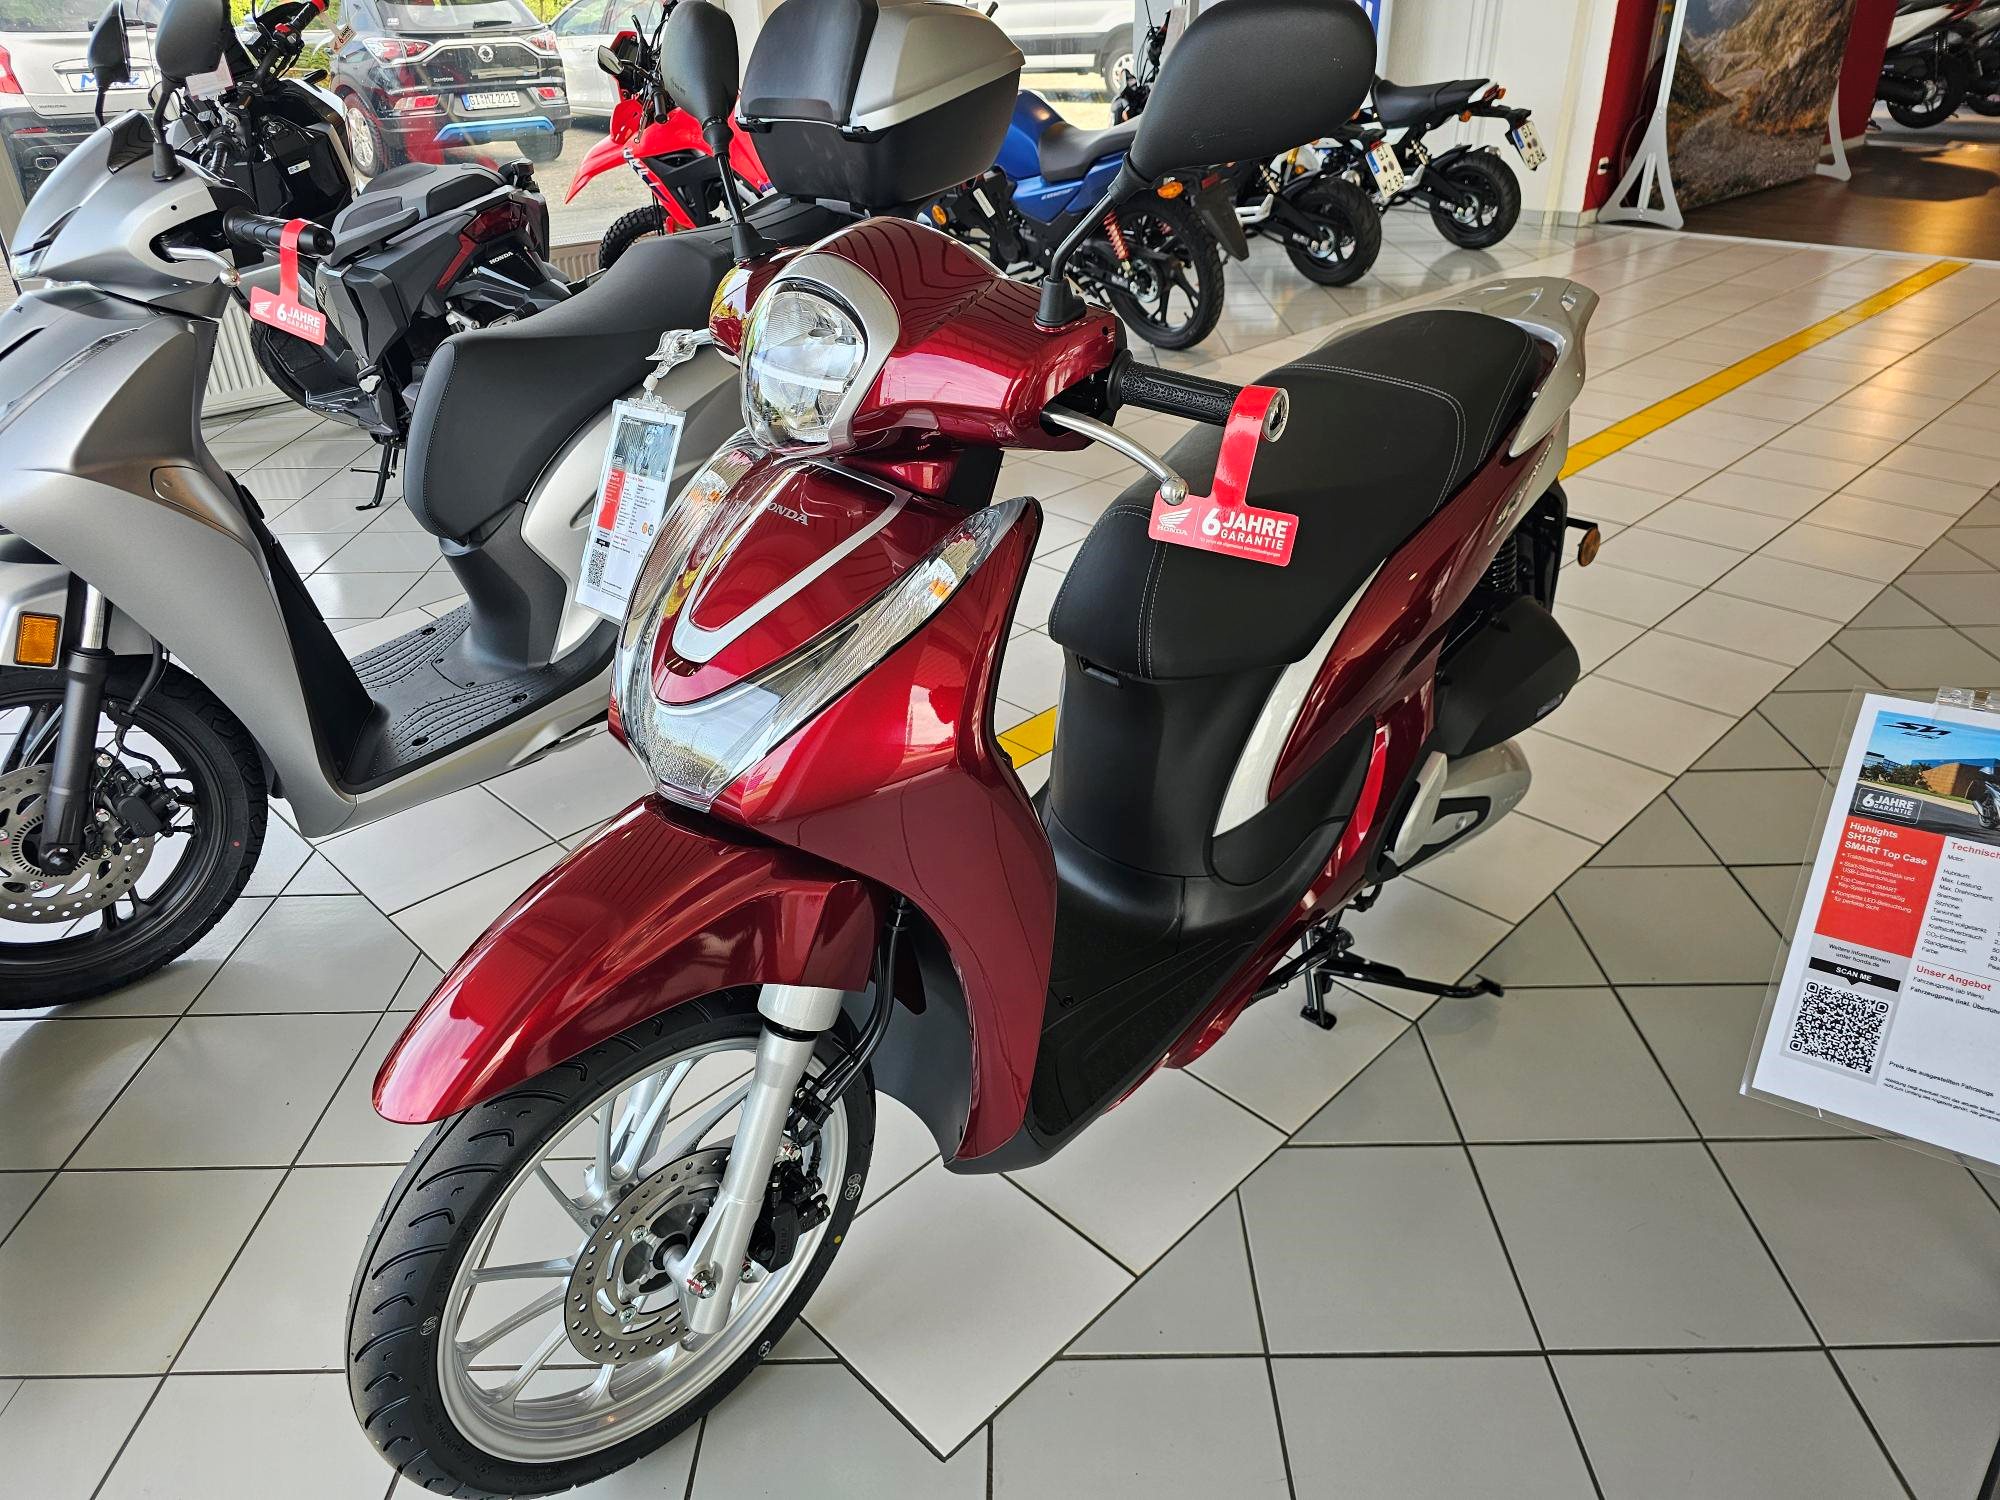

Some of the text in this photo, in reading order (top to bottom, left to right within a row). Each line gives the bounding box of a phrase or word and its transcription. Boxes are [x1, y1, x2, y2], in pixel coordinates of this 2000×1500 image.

[489, 252, 513, 264] HONDA
[277, 304, 320, 328] 6 JAHRE
[1157, 524, 1188, 535] HONDA
[1202, 508, 1289, 539] 6 JAHRE
[1220, 530, 1285, 550] GARANTIE
[1862, 793, 1915, 810] 6 JAHRE
[1874, 803, 1913, 816] GARANTIE
[1847, 832, 1880, 844] SH125i
[1850, 822, 1898, 839] Highlights
[1844, 841, 1927, 866] SMART Top Case
[1828, 943, 1851, 952] Weitere
[1835, 966, 1872, 982] SCAN ME
[1916, 964, 1992, 991] Unser Angebot
